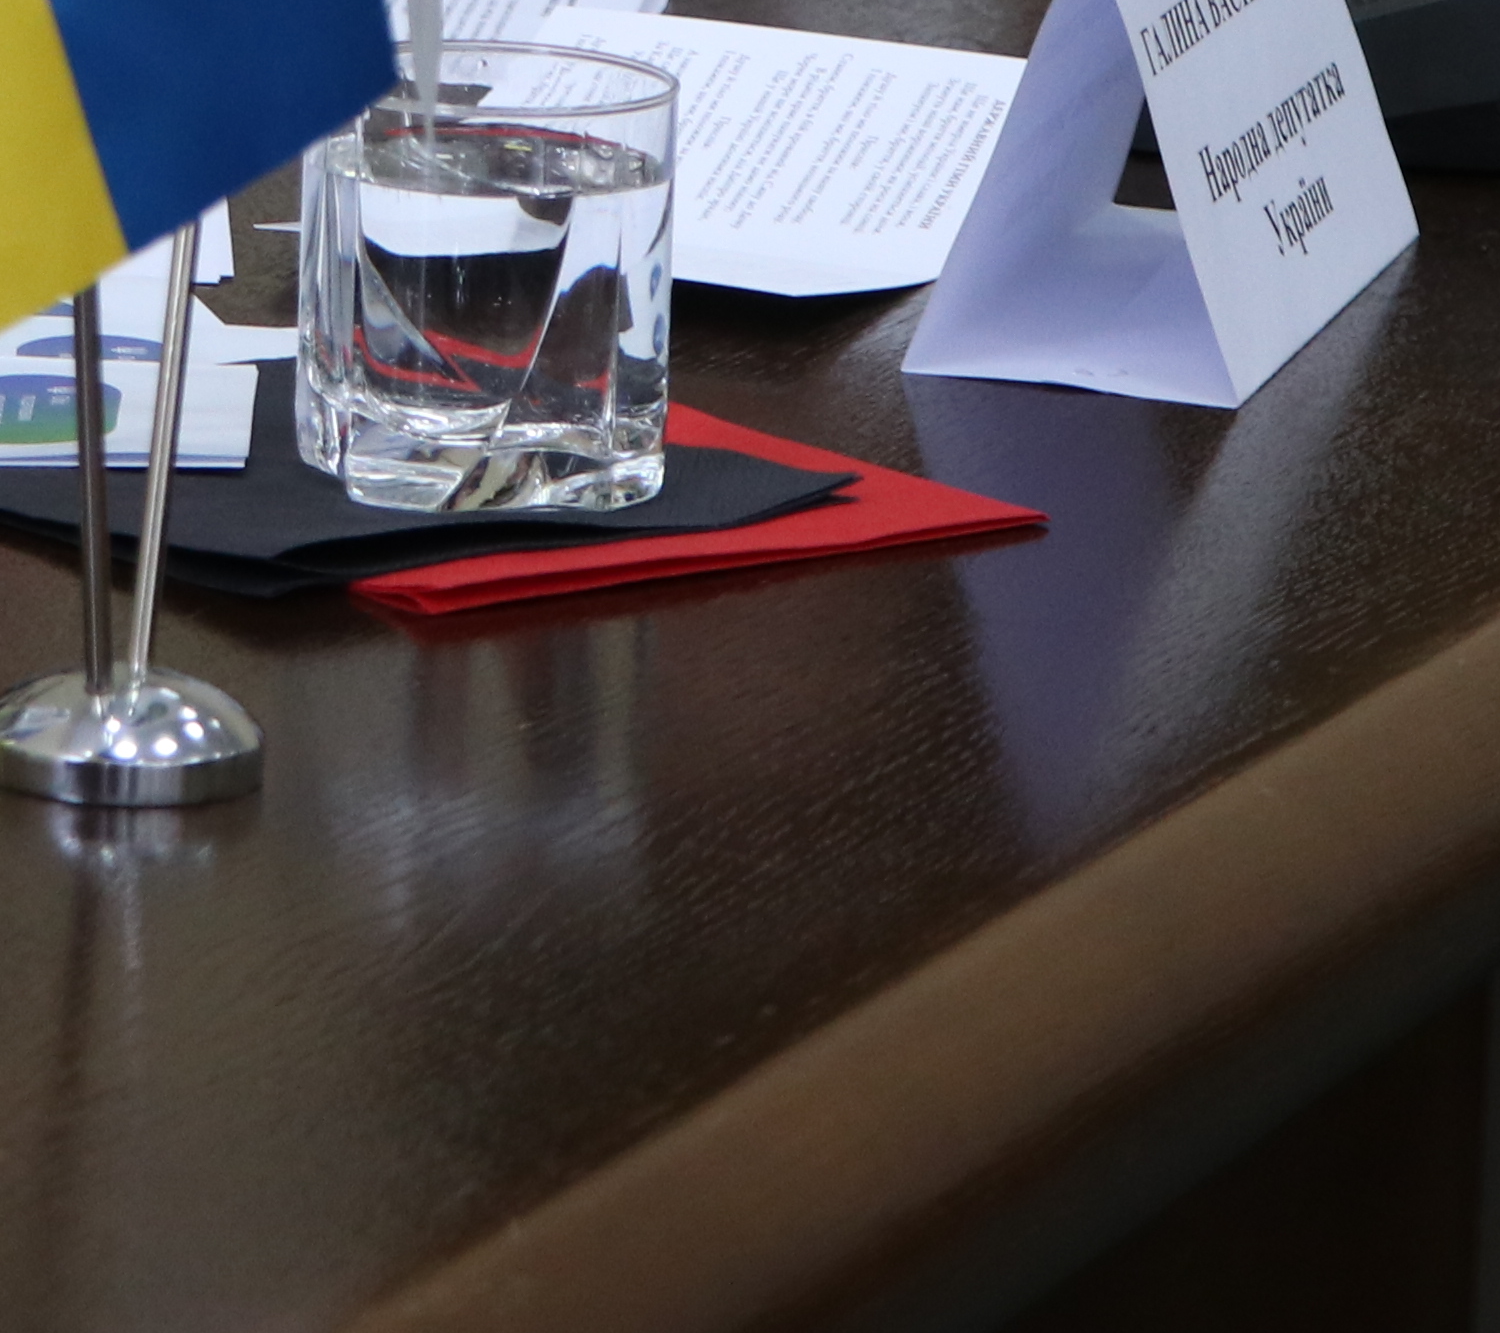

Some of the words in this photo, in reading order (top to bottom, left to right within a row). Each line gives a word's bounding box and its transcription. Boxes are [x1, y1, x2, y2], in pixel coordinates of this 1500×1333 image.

[1199, 119, 1272, 203] Народна
[1266, 62, 1345, 155] депутатка
[1264, 176, 1334, 256] України
